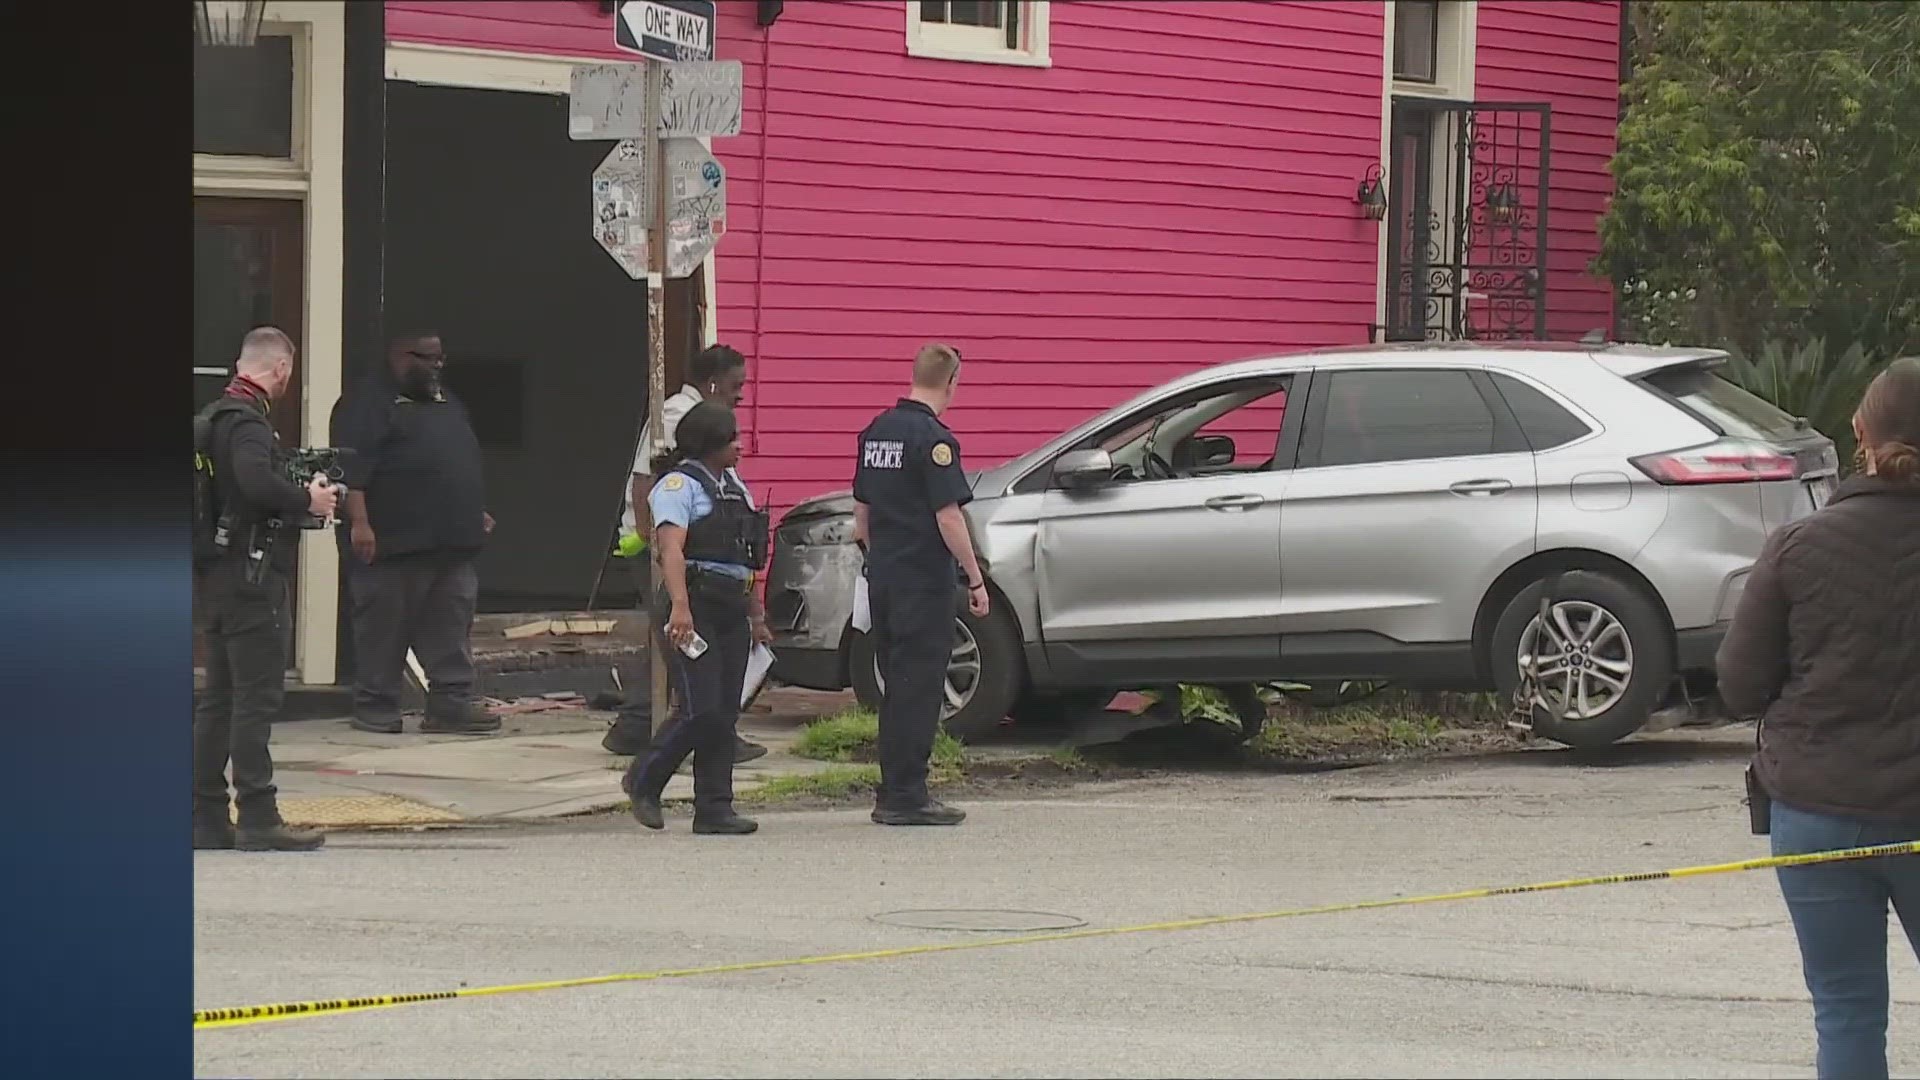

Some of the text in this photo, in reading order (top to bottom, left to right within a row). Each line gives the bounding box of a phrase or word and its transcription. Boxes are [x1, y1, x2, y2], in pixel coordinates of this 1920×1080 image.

[645, 5, 704, 46] ONE WAY
[864, 450, 903, 468] POLICE
